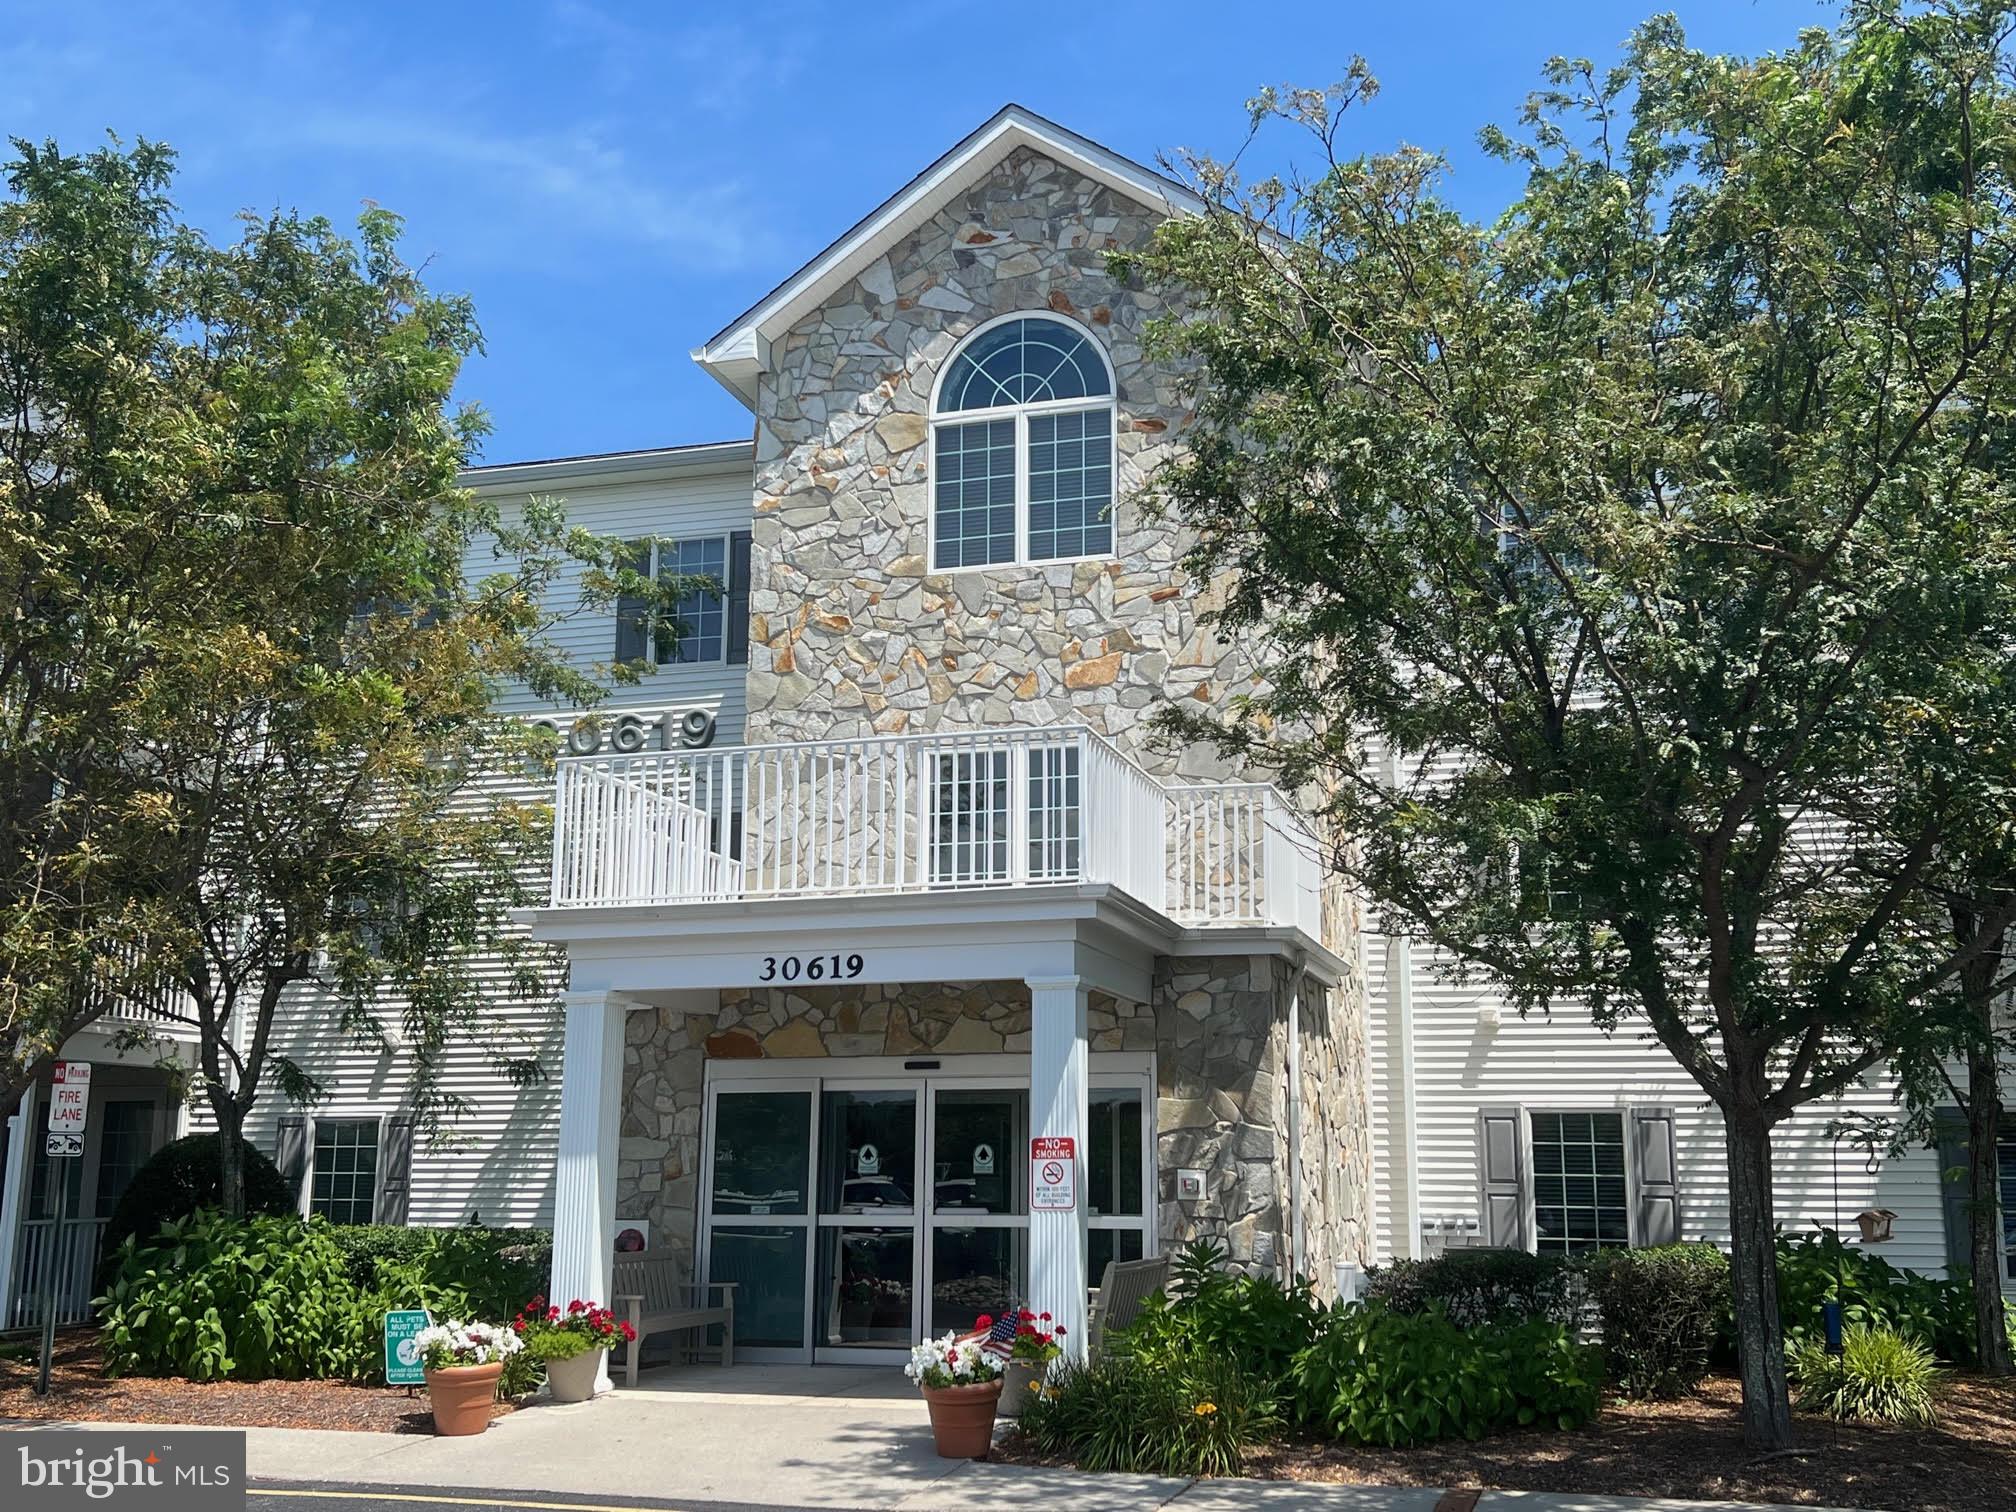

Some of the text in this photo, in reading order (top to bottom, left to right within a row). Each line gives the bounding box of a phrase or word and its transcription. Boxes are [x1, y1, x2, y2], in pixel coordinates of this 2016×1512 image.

[759, 954, 864, 981] 30619
[55, 1068, 89, 1079] NO PARKING
[58, 1091, 81, 1103] FIRE
[53, 1108, 83, 1121] LANE
[1035, 1149, 1071, 1159] SMOKING
